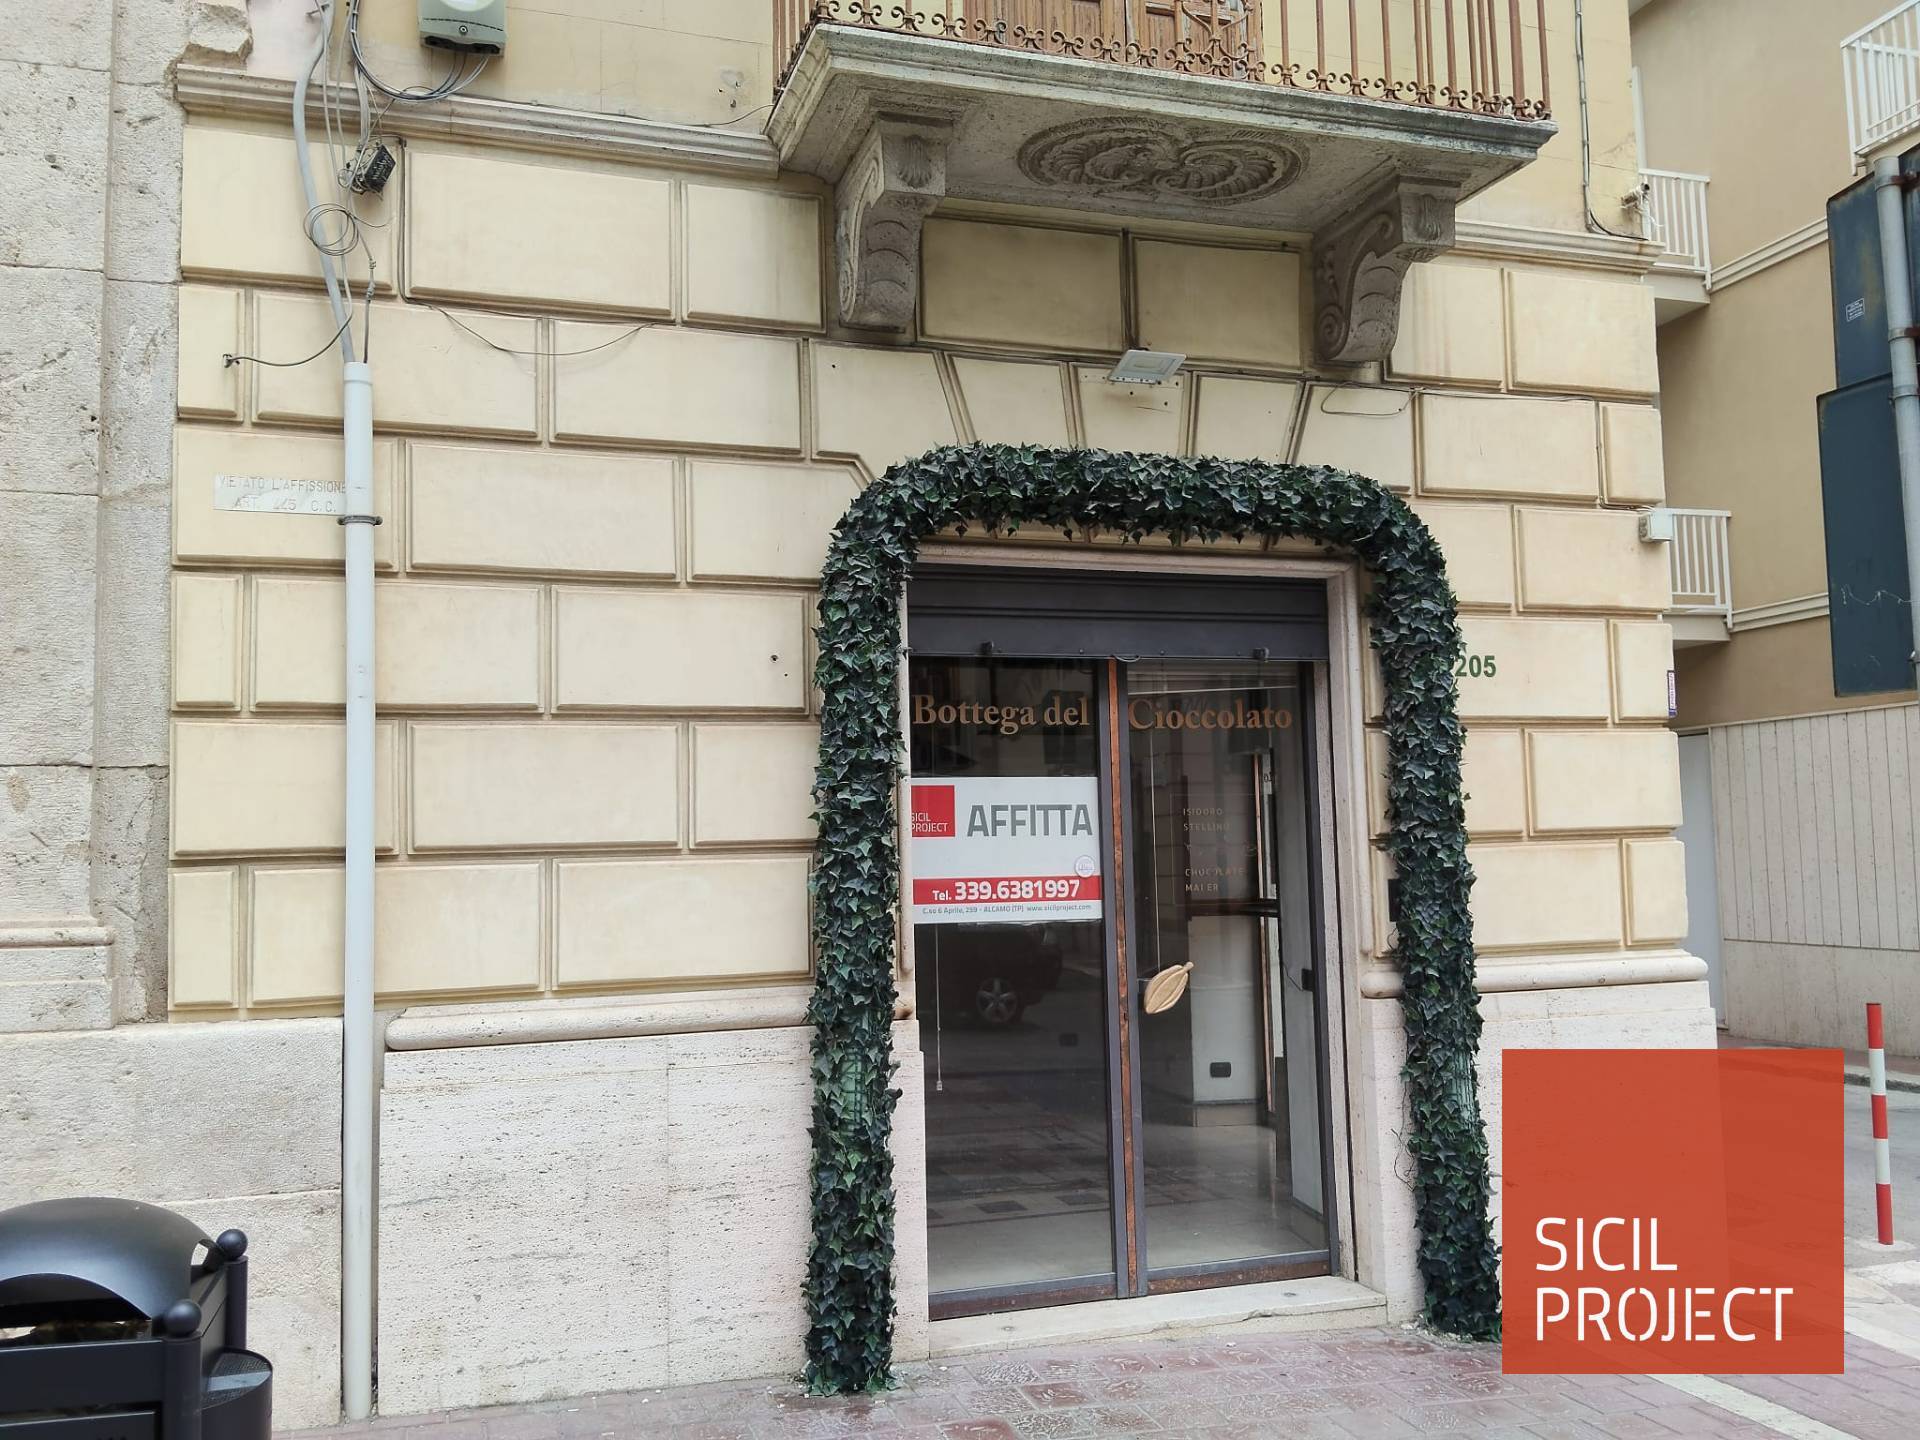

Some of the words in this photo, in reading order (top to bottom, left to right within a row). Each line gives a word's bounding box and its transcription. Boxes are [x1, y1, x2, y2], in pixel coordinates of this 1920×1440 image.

[1455, 654, 1497, 678] 205
[912, 695, 1036, 734] Bottega
[1043, 696, 1090, 726] del
[1129, 697, 1293, 730] Cioccolato
[911, 812, 932, 822] SICIL
[911, 822, 949, 833] PROJECT
[967, 804, 1093, 838] AFFITTA
[932, 889, 952, 901] Tel.
[954, 879, 1080, 901] 339.6381997
[984, 904, 1011, 913] ALCAMO
